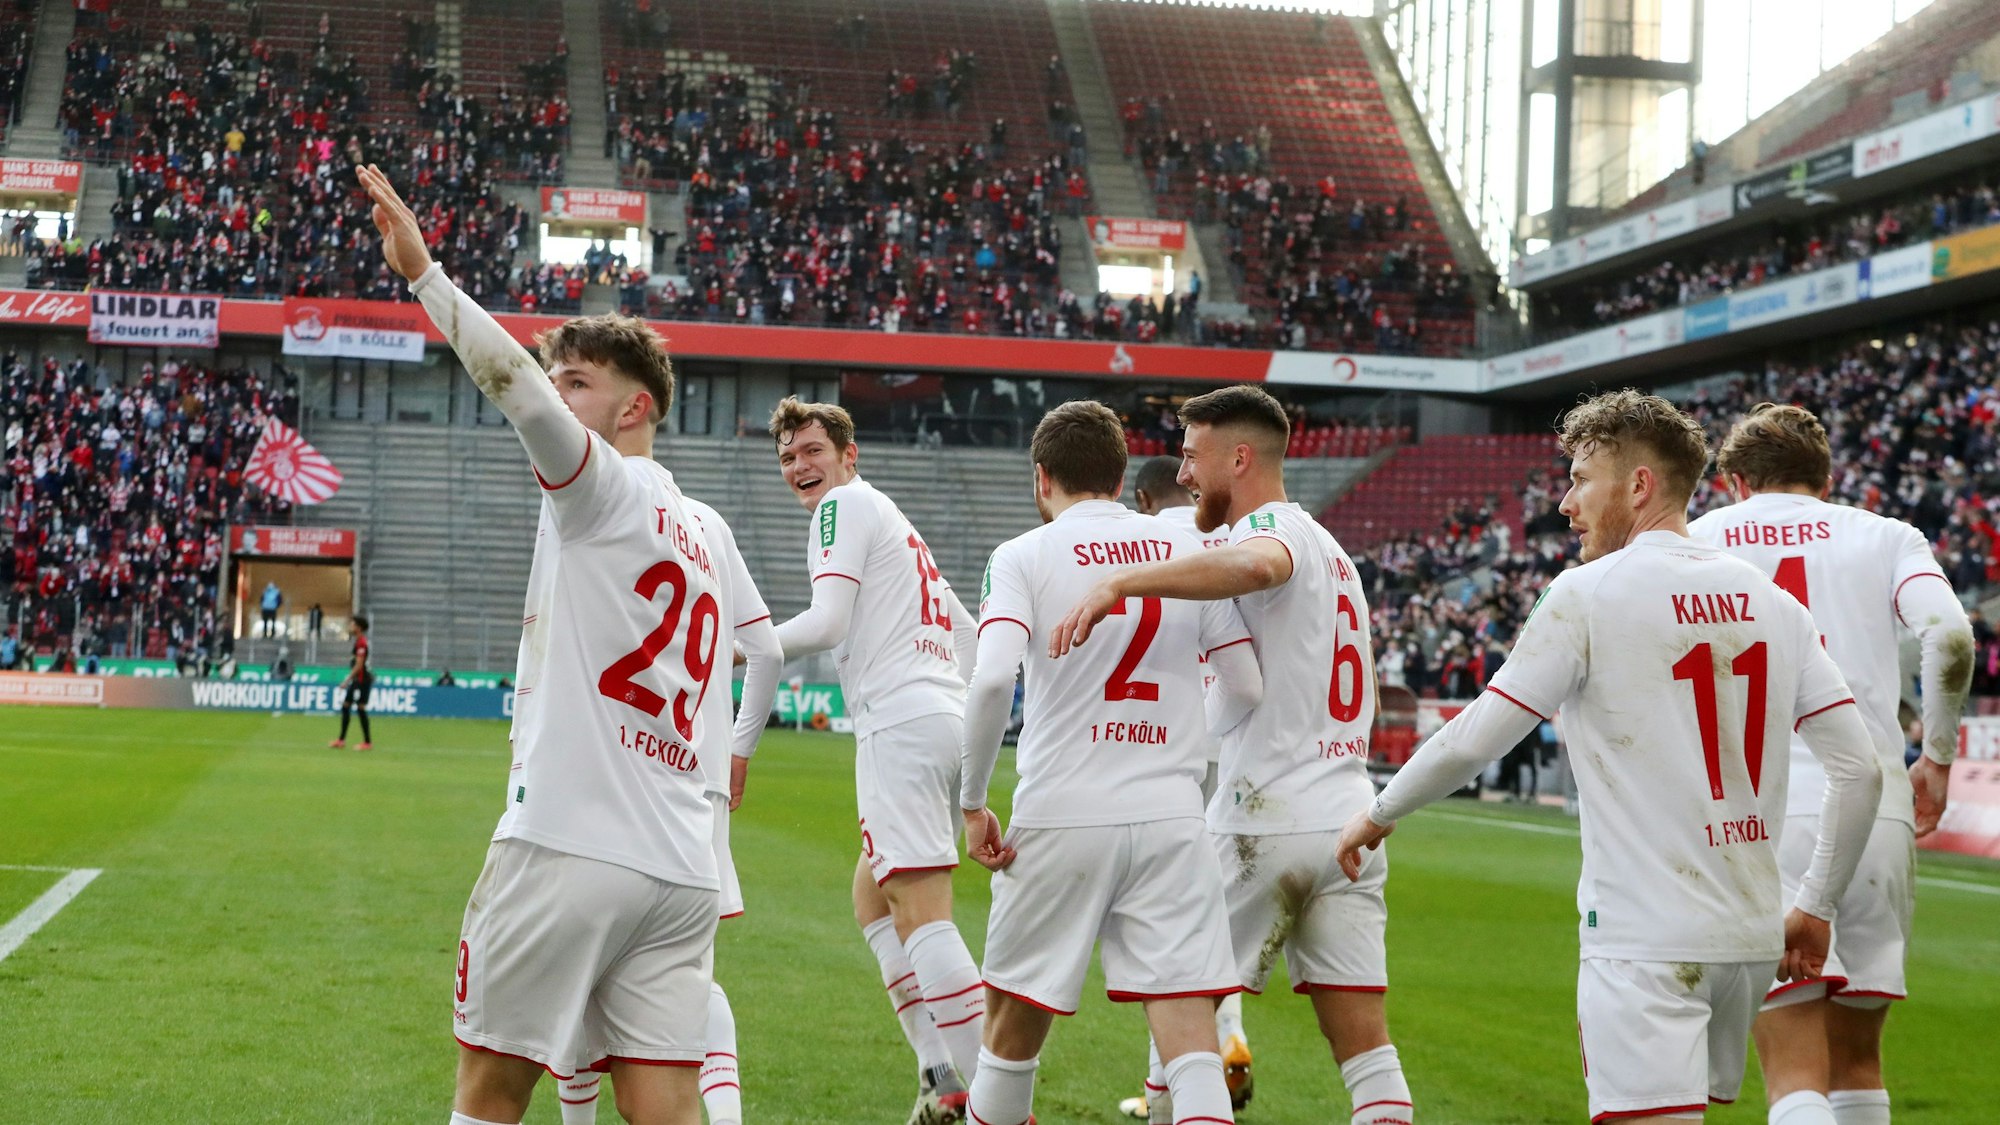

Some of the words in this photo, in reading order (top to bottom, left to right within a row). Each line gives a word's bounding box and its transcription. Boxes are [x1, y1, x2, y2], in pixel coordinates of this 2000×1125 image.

[92, 296, 216, 318] LINDLAR
[108, 322, 169, 337] feuert
[177, 326, 200, 338] an
[819, 505, 834, 544] DEVK
[1725, 521, 1830, 547] HÜBERS
[1074, 540, 1172, 566] SCHMITZ
[1672, 593, 1755, 624] KAINZ
[598, 560, 719, 742] 29
[1104, 597, 1162, 701] 2
[1329, 594, 1364, 722] 6
[192, 682, 285, 709] WORKOUT
[288, 684, 329, 711] LIFE
[332, 687, 418, 714] BANCE
[776, 690, 833, 714] EVK
[1105, 722, 1125, 742] FC
[1128, 720, 1167, 745] KÖLN
[1672, 641, 1768, 800] 11
[620, 725, 632, 749] 1.
[658, 739, 698, 772] KÖLN
[1327, 741, 1345, 759] FC
[1345, 736, 1367, 758] KÖ
[1705, 824, 1720, 847] 1.
[1735, 815, 1769, 843] KÖL
